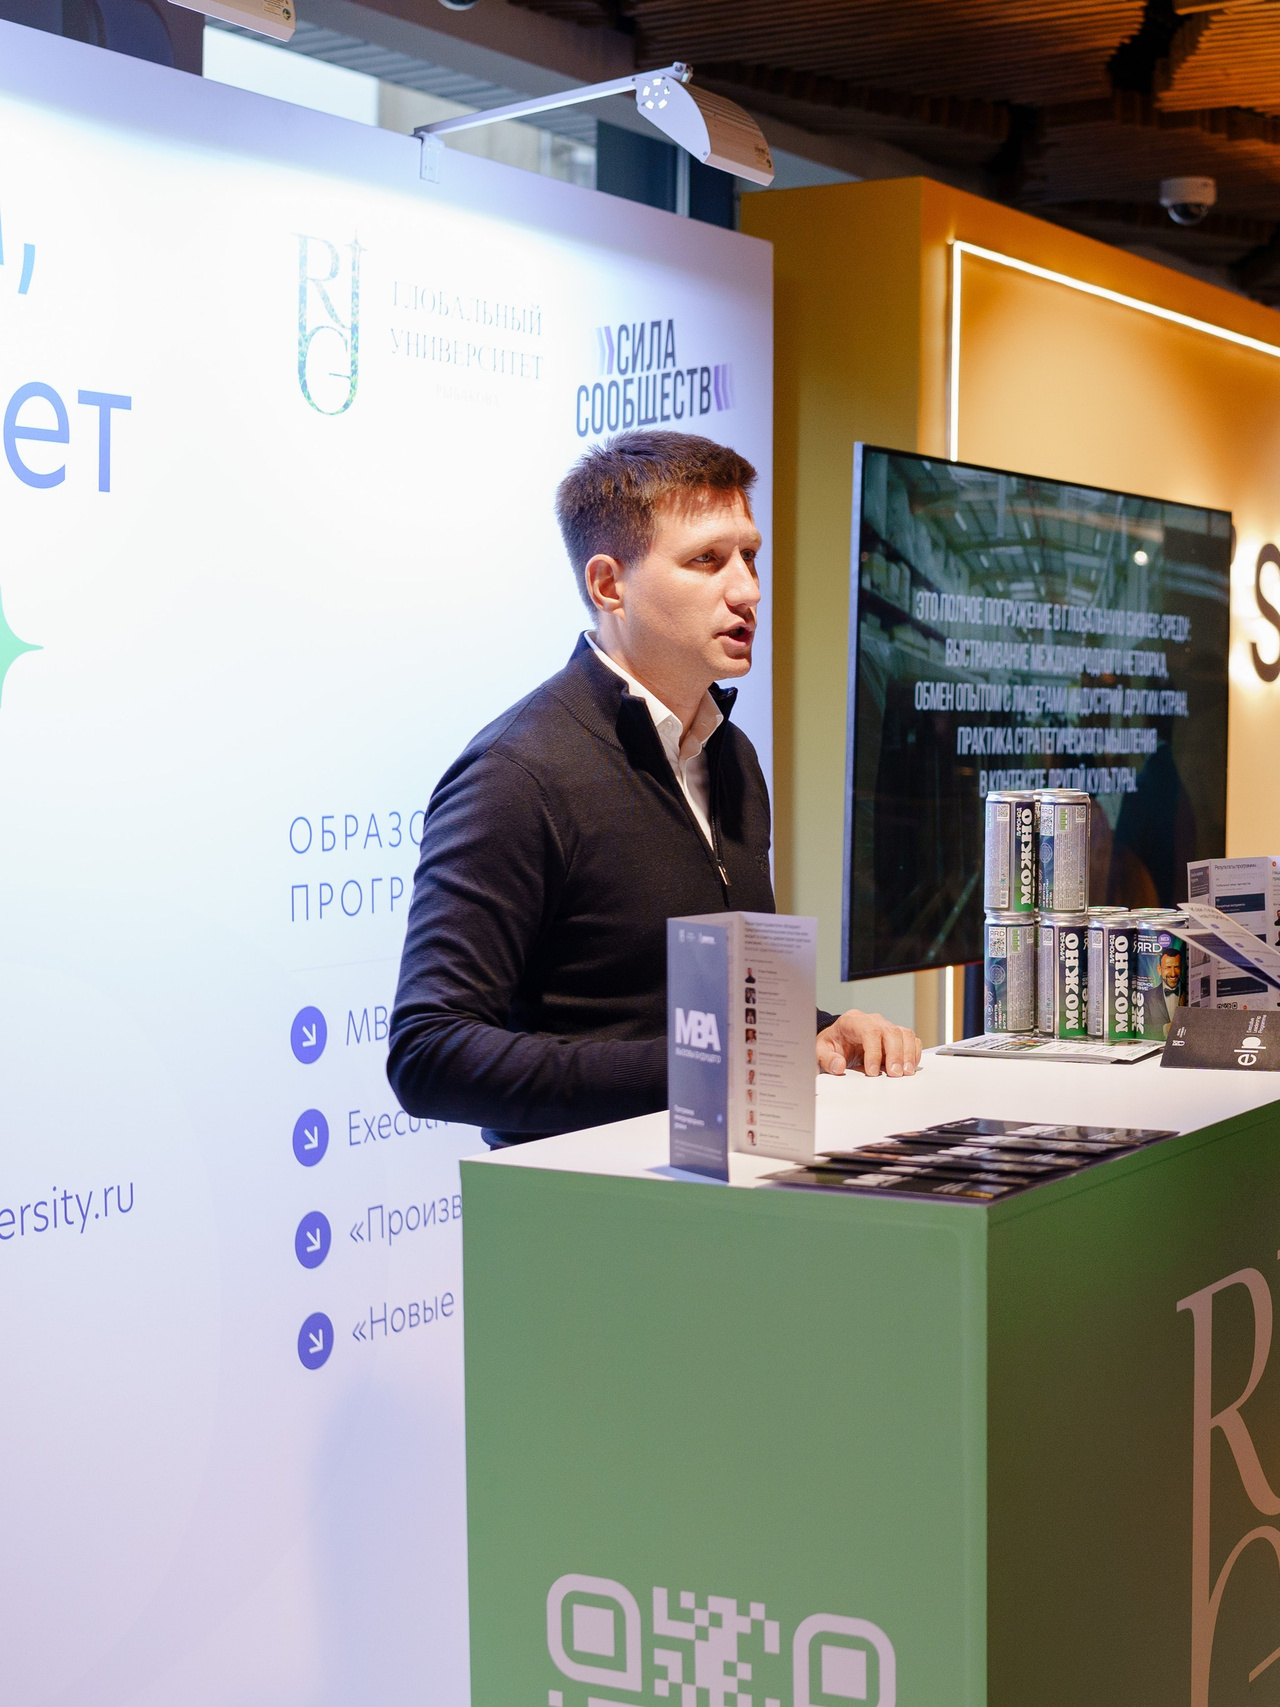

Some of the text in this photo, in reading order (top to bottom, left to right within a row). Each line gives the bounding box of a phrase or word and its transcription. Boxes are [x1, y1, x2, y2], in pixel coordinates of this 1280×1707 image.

[616, 318, 677, 376] СИЛА
[576, 366, 712, 439] СООБЩЕСТВ
[915, 591, 939, 621] ЭТО
[940, 593, 984, 626] ПОЛНОЕ
[985, 597, 1052, 631] ПОГРУЖЕНИЕ
[1053, 603, 1062, 631] В
[944, 638, 1030, 671] ВЫСТРАИВАНИЕ
[1030, 644, 1122, 678] МЕЖДУНАРОДНОГО
[914, 681, 954, 711] ОБМЕН
[955, 683, 1002, 713] ОПЫТОМ
[1003, 684, 1011, 713] С
[1011, 685, 1067, 717] ЛИДЕРАМИ
[1067, 684, 1123, 717] ИНДУСТРИЙ
[1123, 687, 1160, 718] ДРУГИХ
[957, 726, 1013, 755] ПРАКТИКА
[1014, 727, 1104, 755] СТРАТЕГИЧЕСКОГО
[979, 770, 988, 798] В
[675, 1007, 722, 1051] MBA
[1233, 1036, 1267, 1066] elp
[352, 1291, 455, 1342] «Новые
